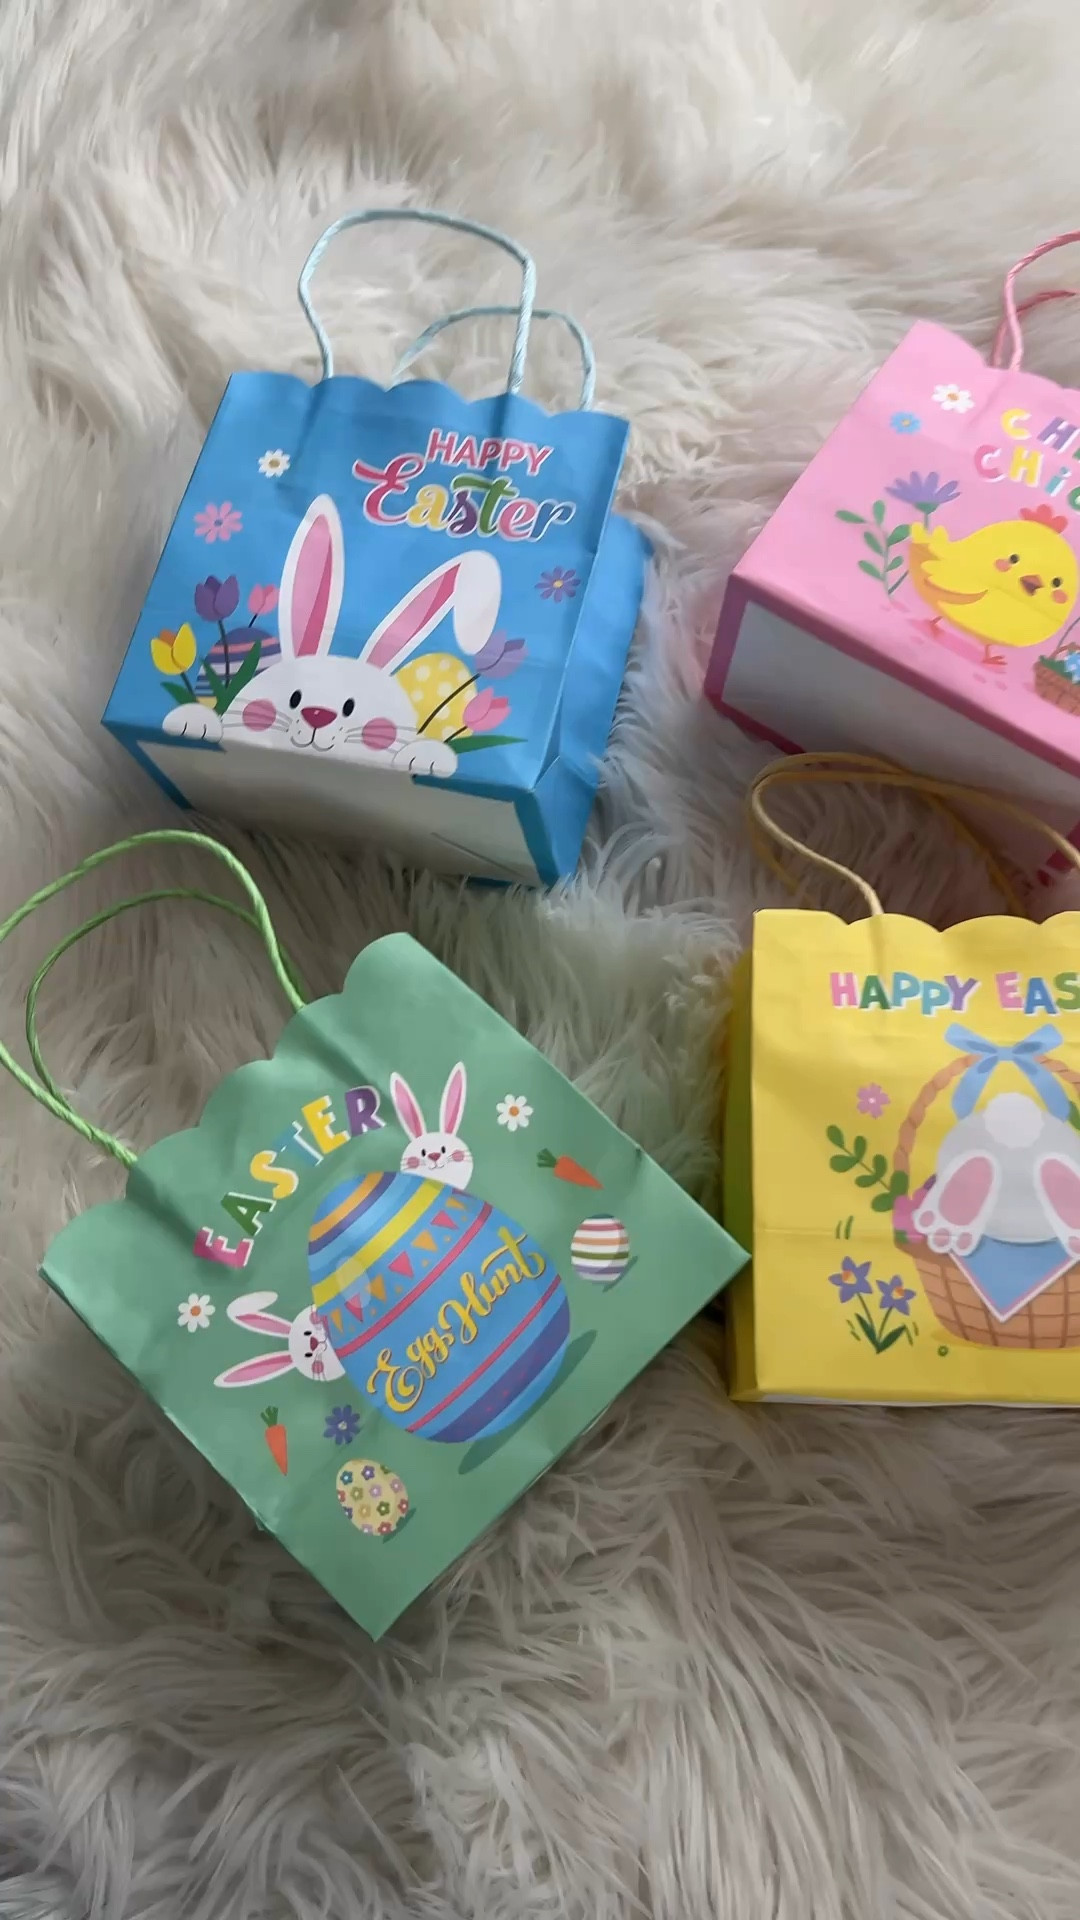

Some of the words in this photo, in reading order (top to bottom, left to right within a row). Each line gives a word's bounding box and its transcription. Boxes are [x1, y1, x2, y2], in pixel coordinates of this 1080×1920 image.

[426, 428, 554, 476] HAPPY
[1000, 407, 1080, 464] CH
[352, 453, 577, 542] Easter
[829, 971, 981, 1017] HAPPY
[995, 971, 1080, 1016] EAS
[192, 1085, 387, 1268] EASTER
[366, 1327, 456, 1413] Egg
[438, 1226, 547, 1344] Hunt
